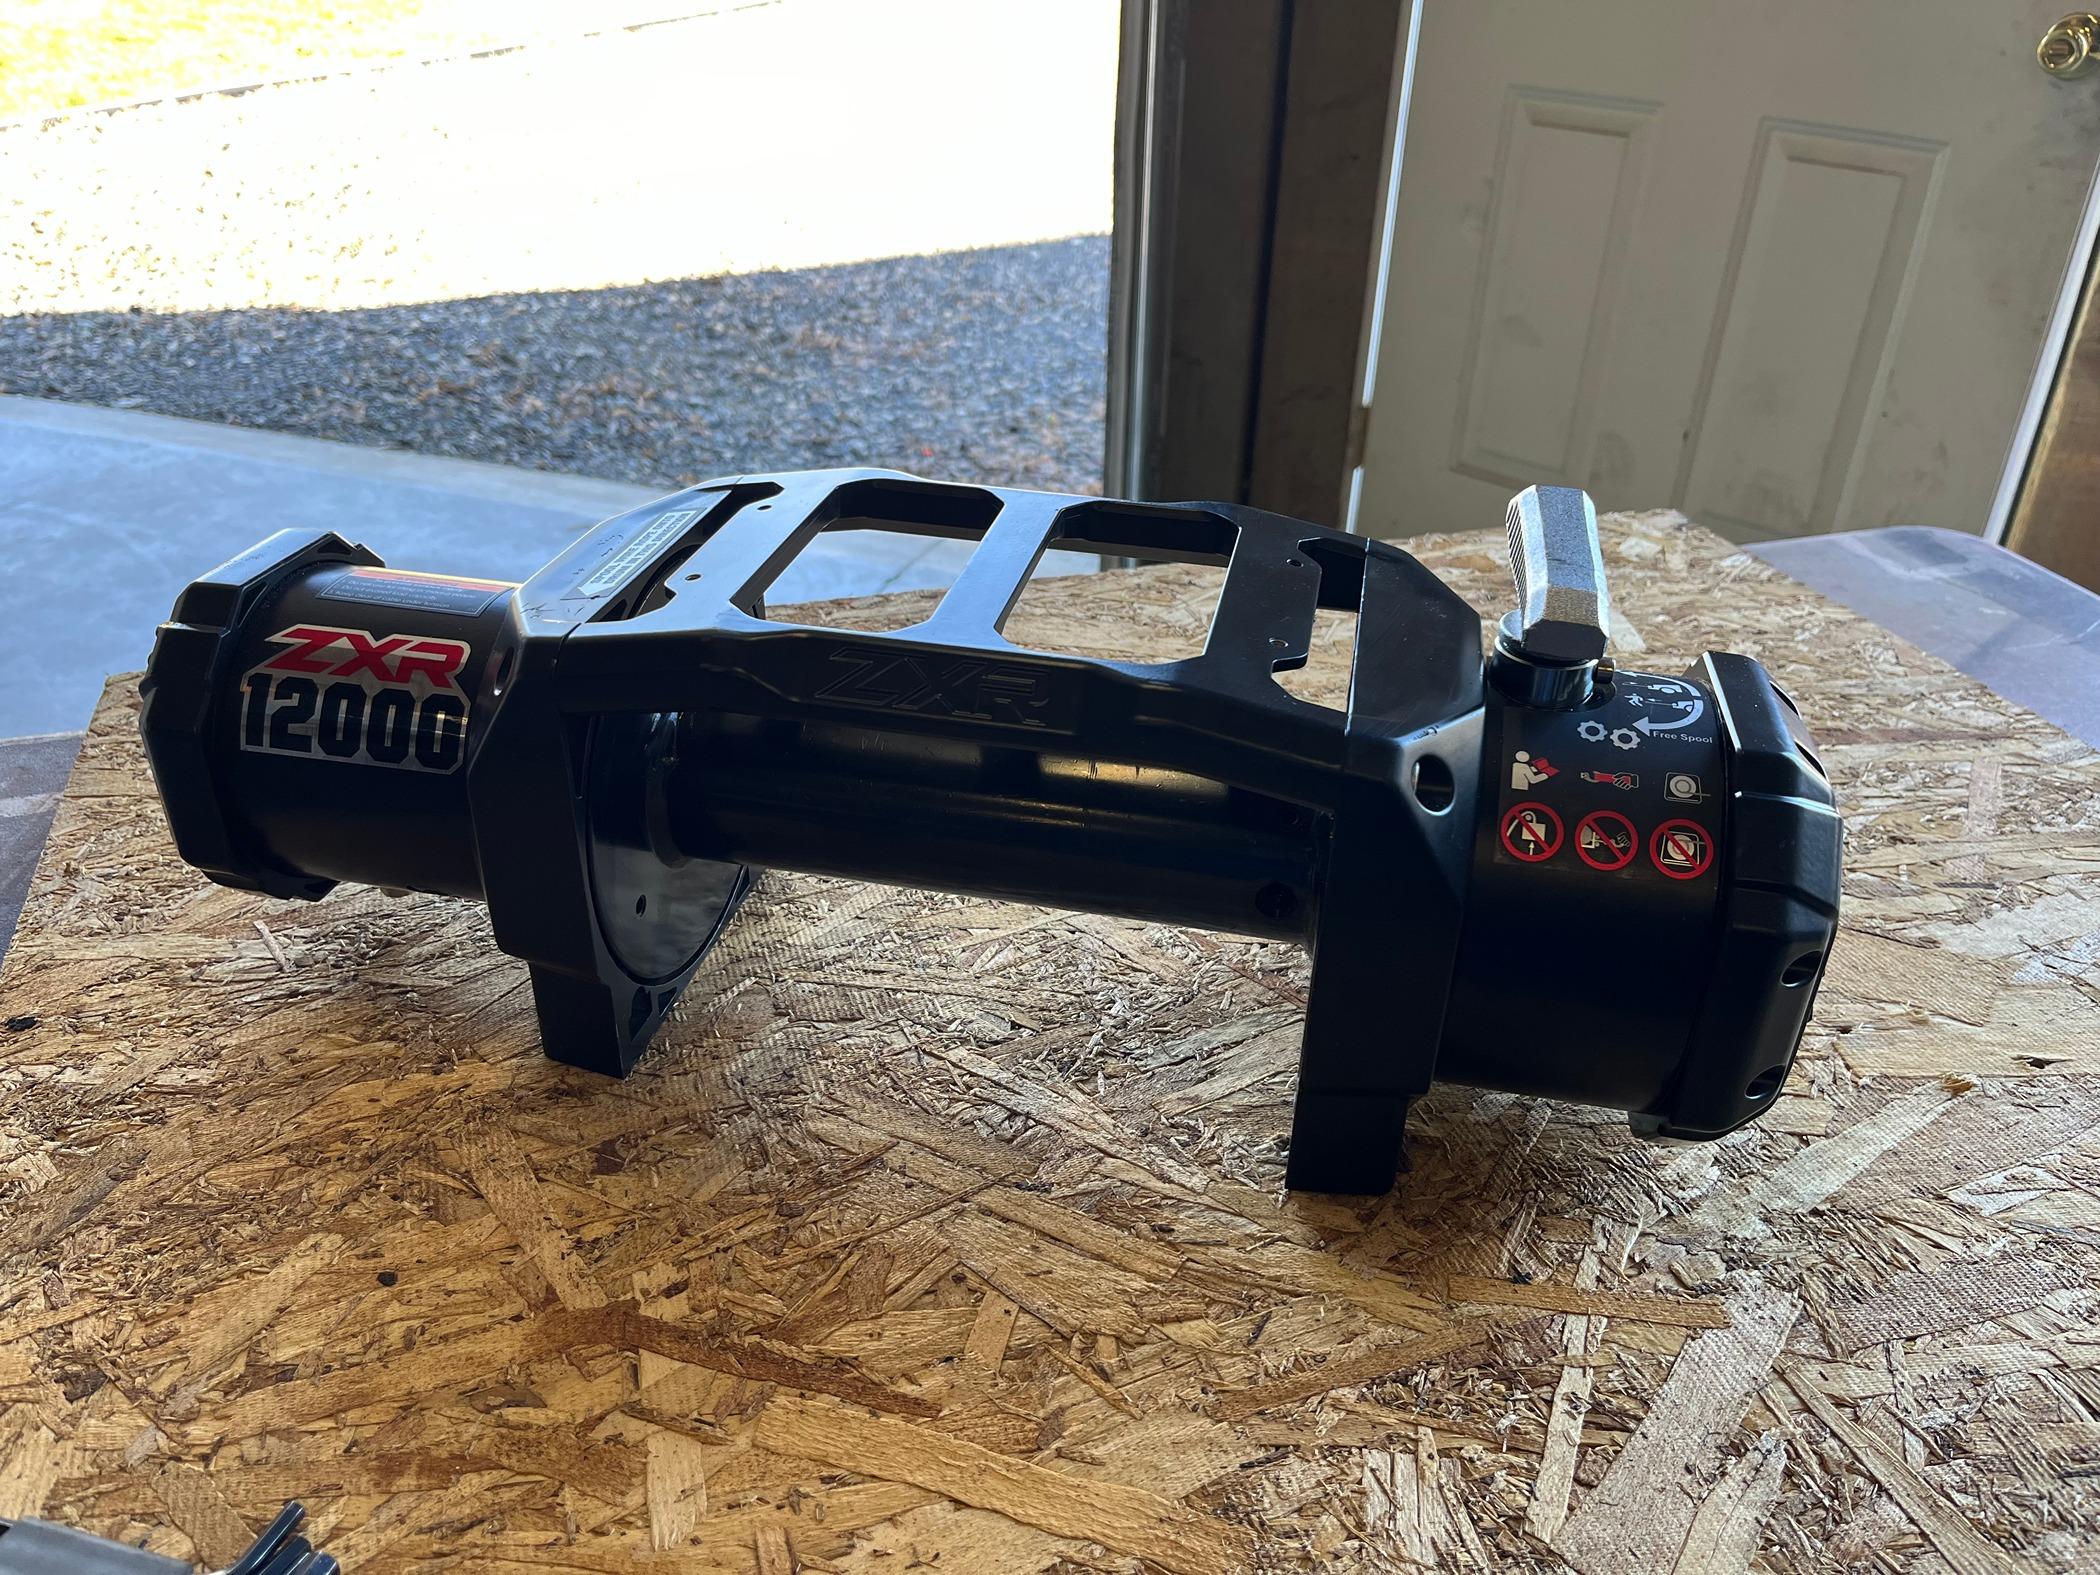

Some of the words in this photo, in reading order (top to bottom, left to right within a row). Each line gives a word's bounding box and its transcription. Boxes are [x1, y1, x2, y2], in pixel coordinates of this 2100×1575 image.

[264, 626, 468, 689] ZXR
[814, 645, 1050, 726] ZXR
[244, 673, 466, 770] 12000
[1652, 730, 1678, 741] Free
[1680, 733, 1713, 744] Spool
